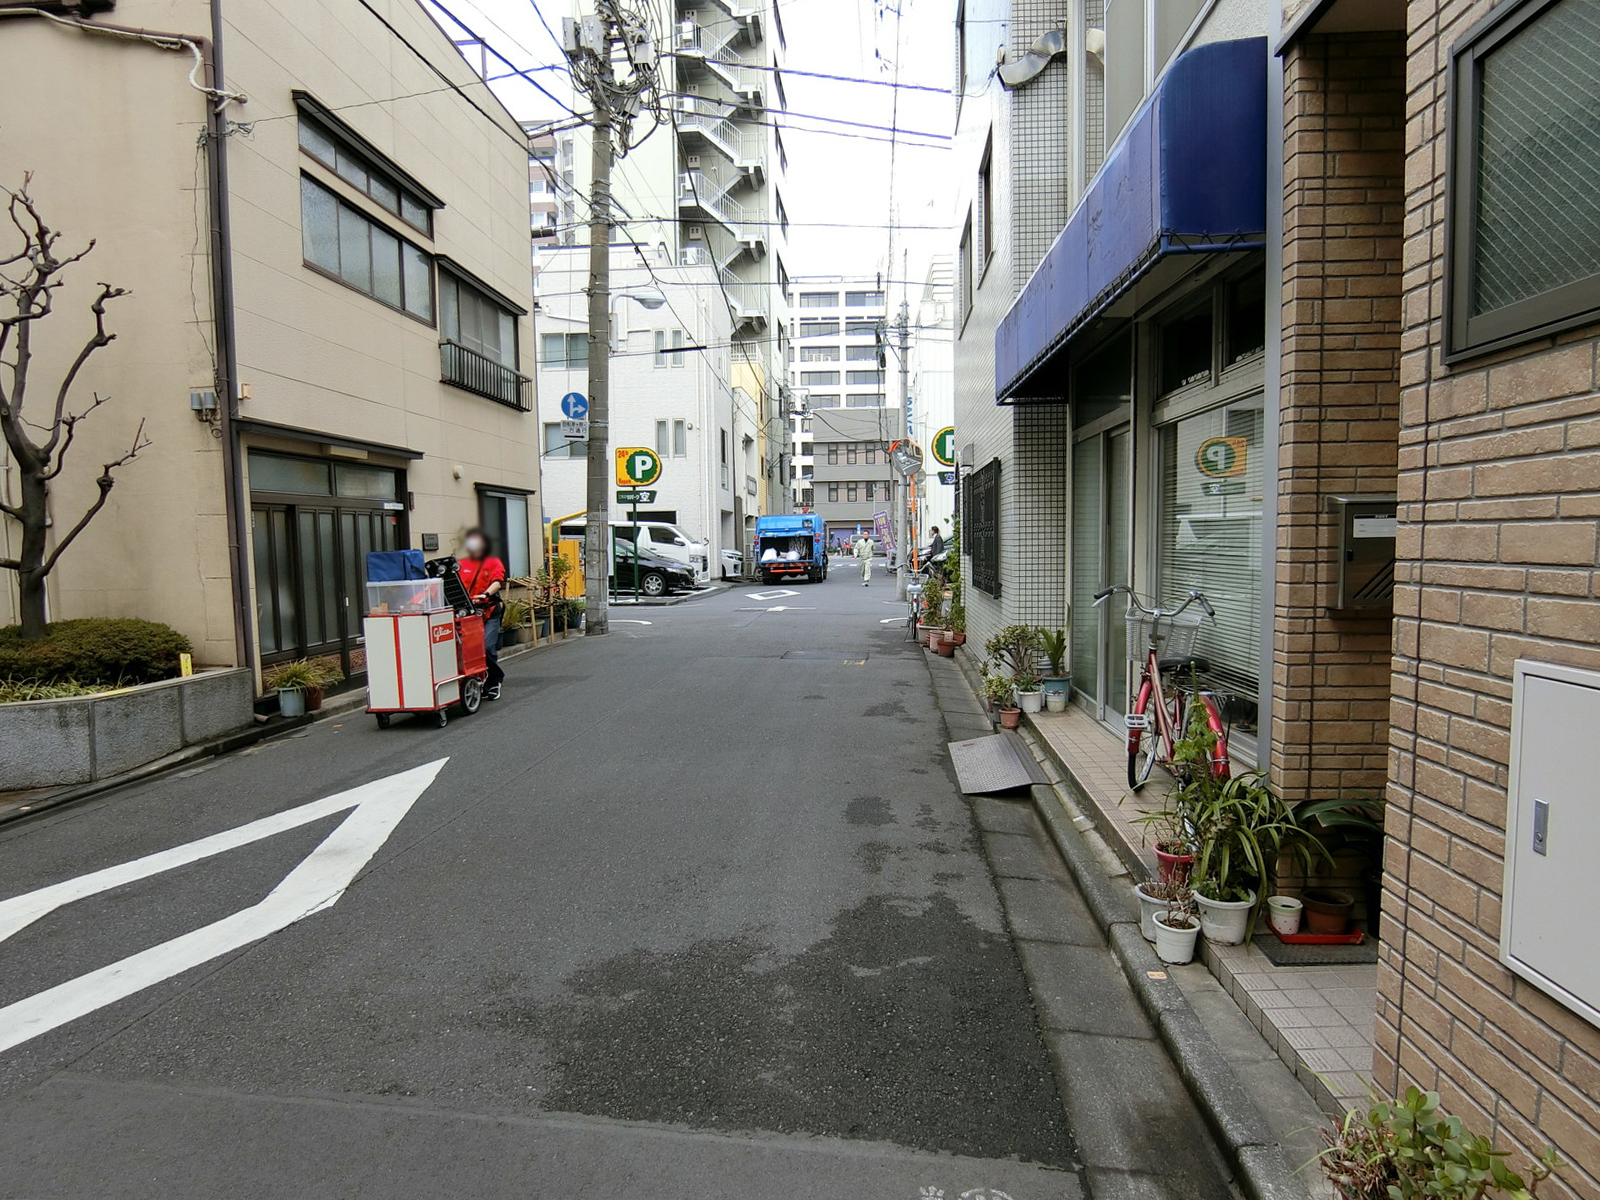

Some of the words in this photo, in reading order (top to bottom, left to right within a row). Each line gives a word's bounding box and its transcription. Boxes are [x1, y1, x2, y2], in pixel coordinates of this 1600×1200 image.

[635, 455, 653, 479] P
[639, 491, 651, 502] 空
[433, 626, 453, 642] Glico
